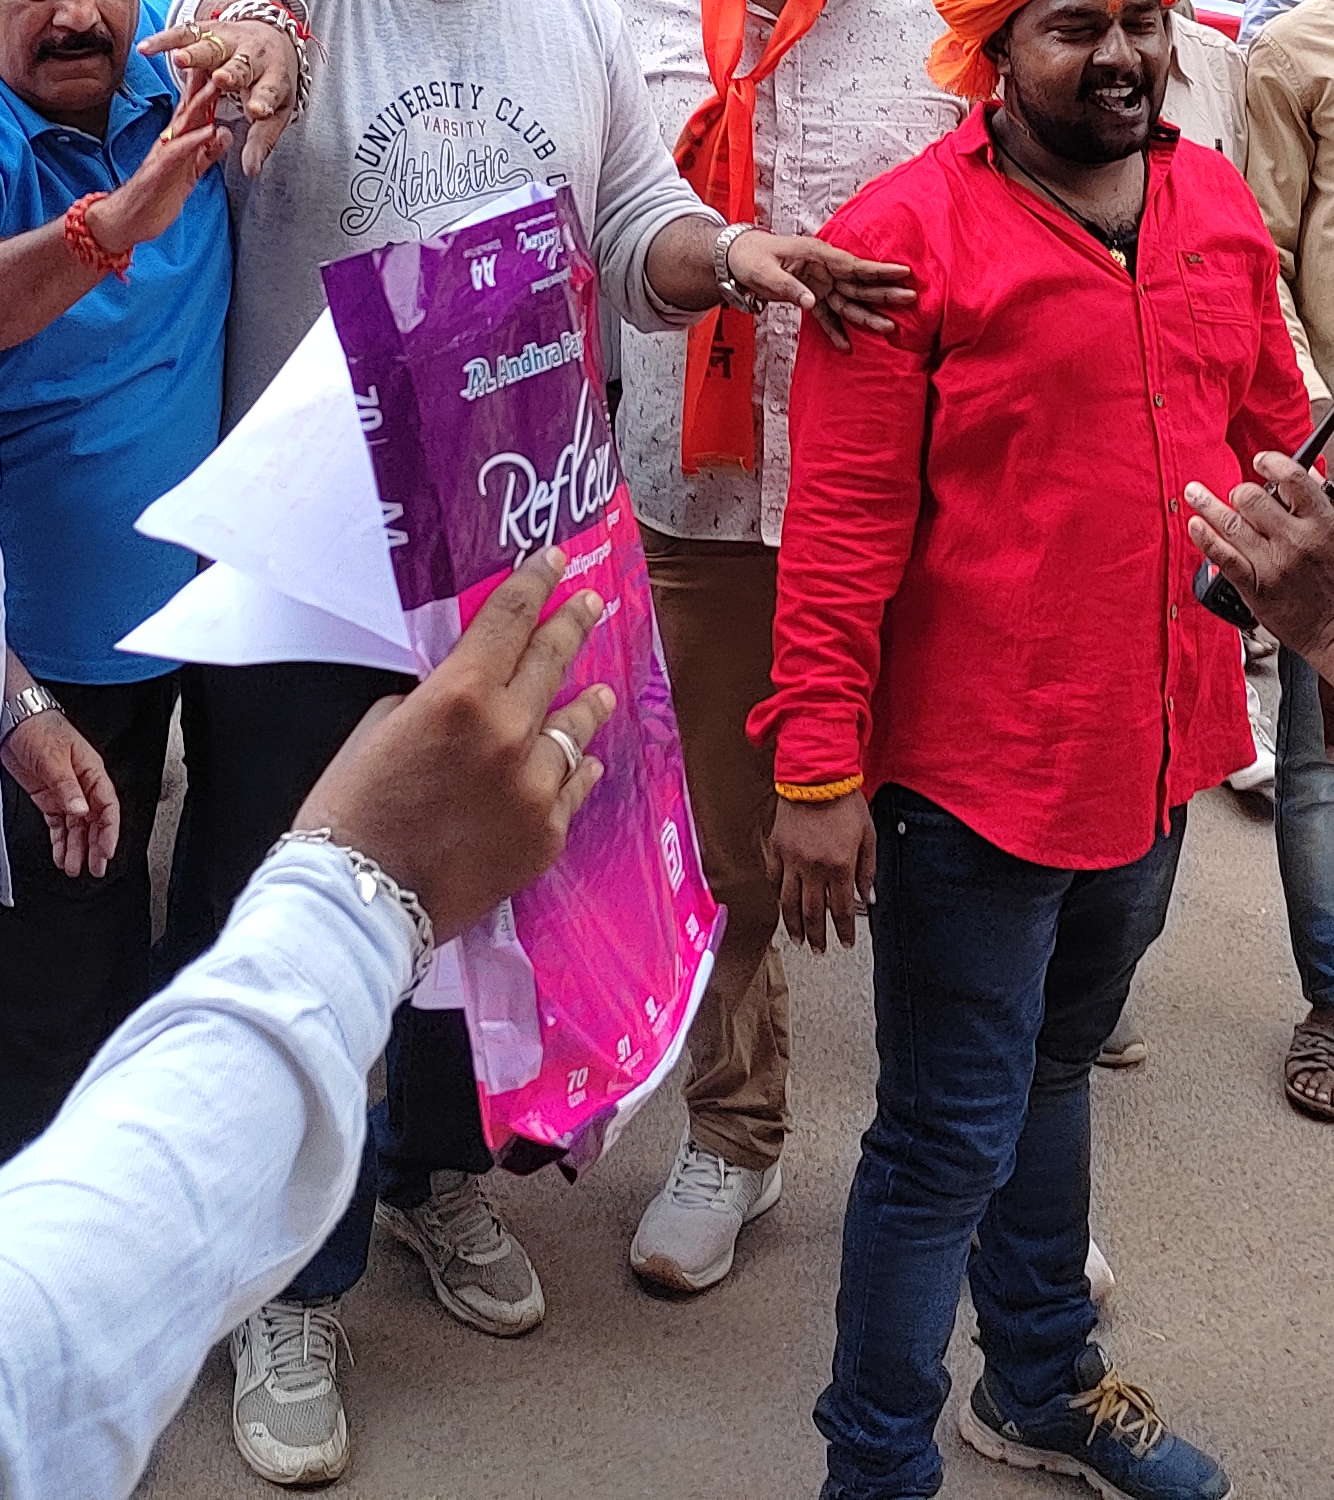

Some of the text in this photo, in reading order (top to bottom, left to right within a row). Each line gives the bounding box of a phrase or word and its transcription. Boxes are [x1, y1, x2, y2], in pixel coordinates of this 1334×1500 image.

[355, 81, 557, 167] UNIVERSITY CLUB
[422, 114, 487, 138] VARSITY
[340, 128, 510, 236] Athletic
[496, 342, 563, 389] Andhra
